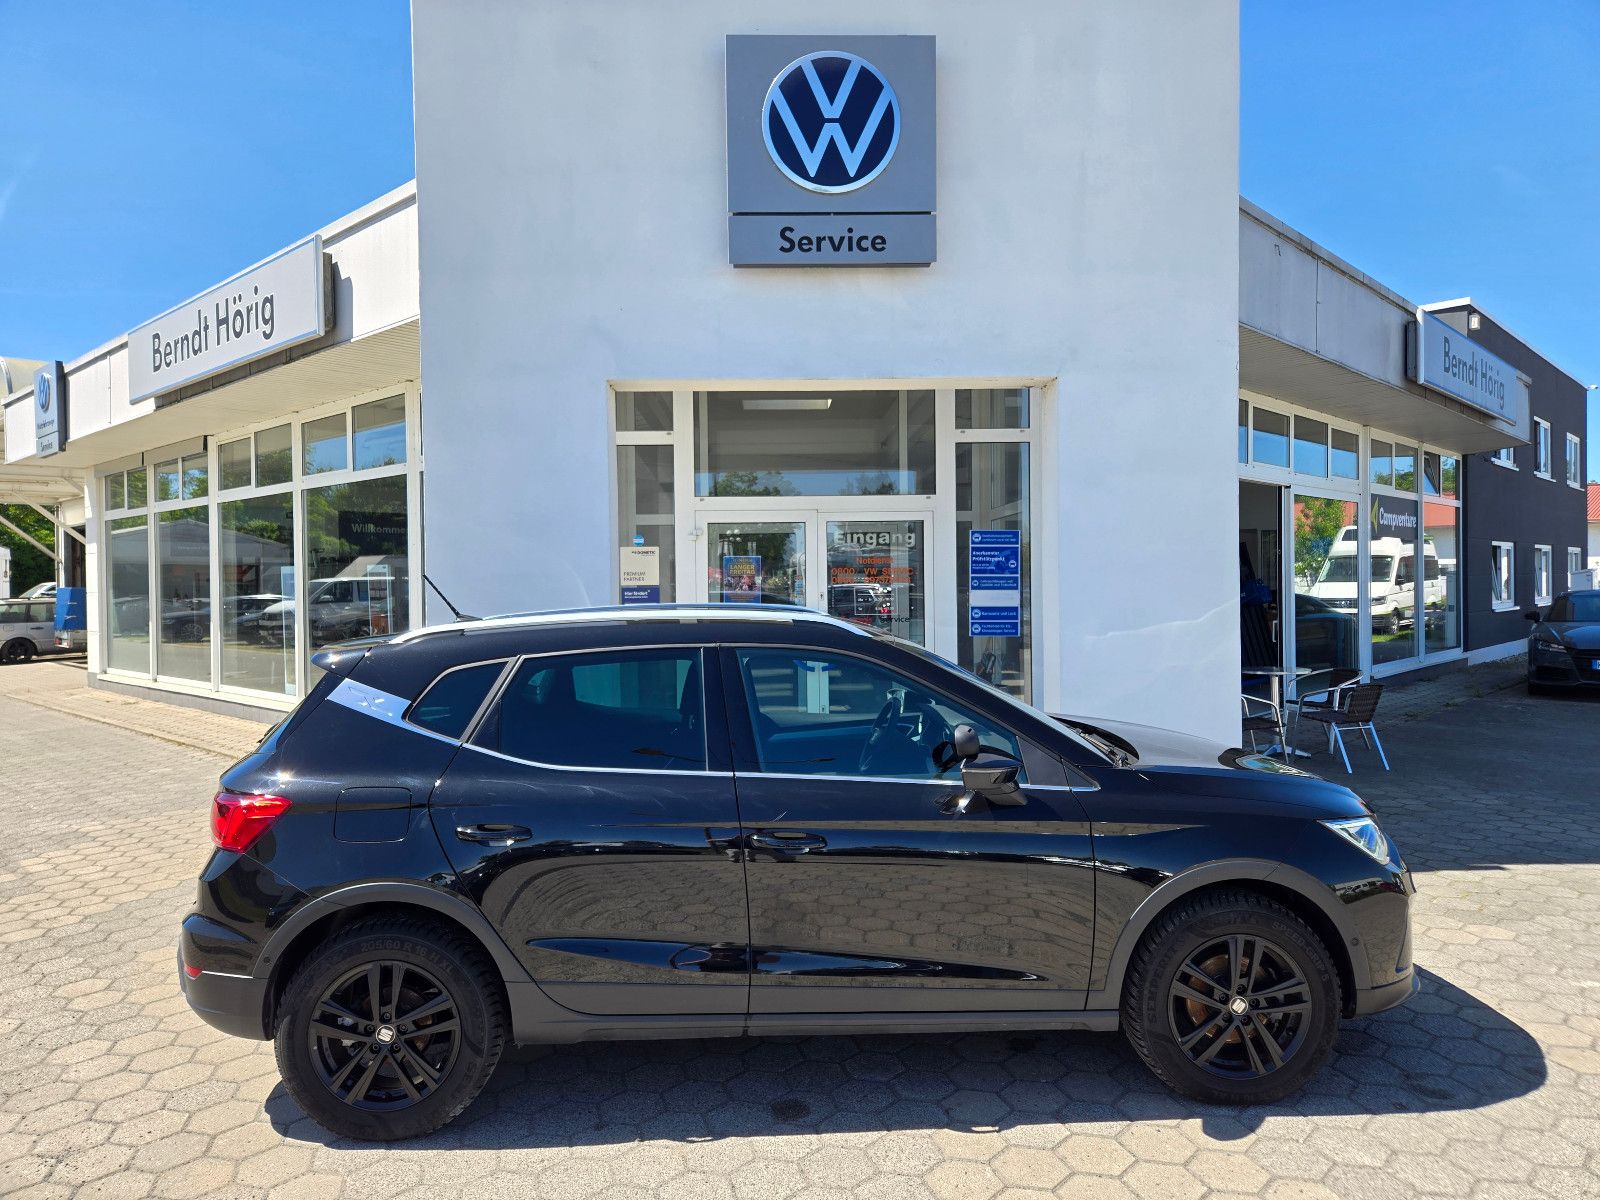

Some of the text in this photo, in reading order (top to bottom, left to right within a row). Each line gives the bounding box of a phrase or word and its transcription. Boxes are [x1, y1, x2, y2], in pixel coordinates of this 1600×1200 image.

[778, 226, 887, 253] Service
[151, 285, 275, 373] Berndt Hörig
[1443, 336, 1505, 411] Berndt Hörig
[351, 523, 408, 534] Willkomme
[1379, 507, 1417, 531] Campventure
[833, 530, 917, 548] Eingang
[360, 939, 401, 952] 205/60
[415, 945, 429, 956] 16
